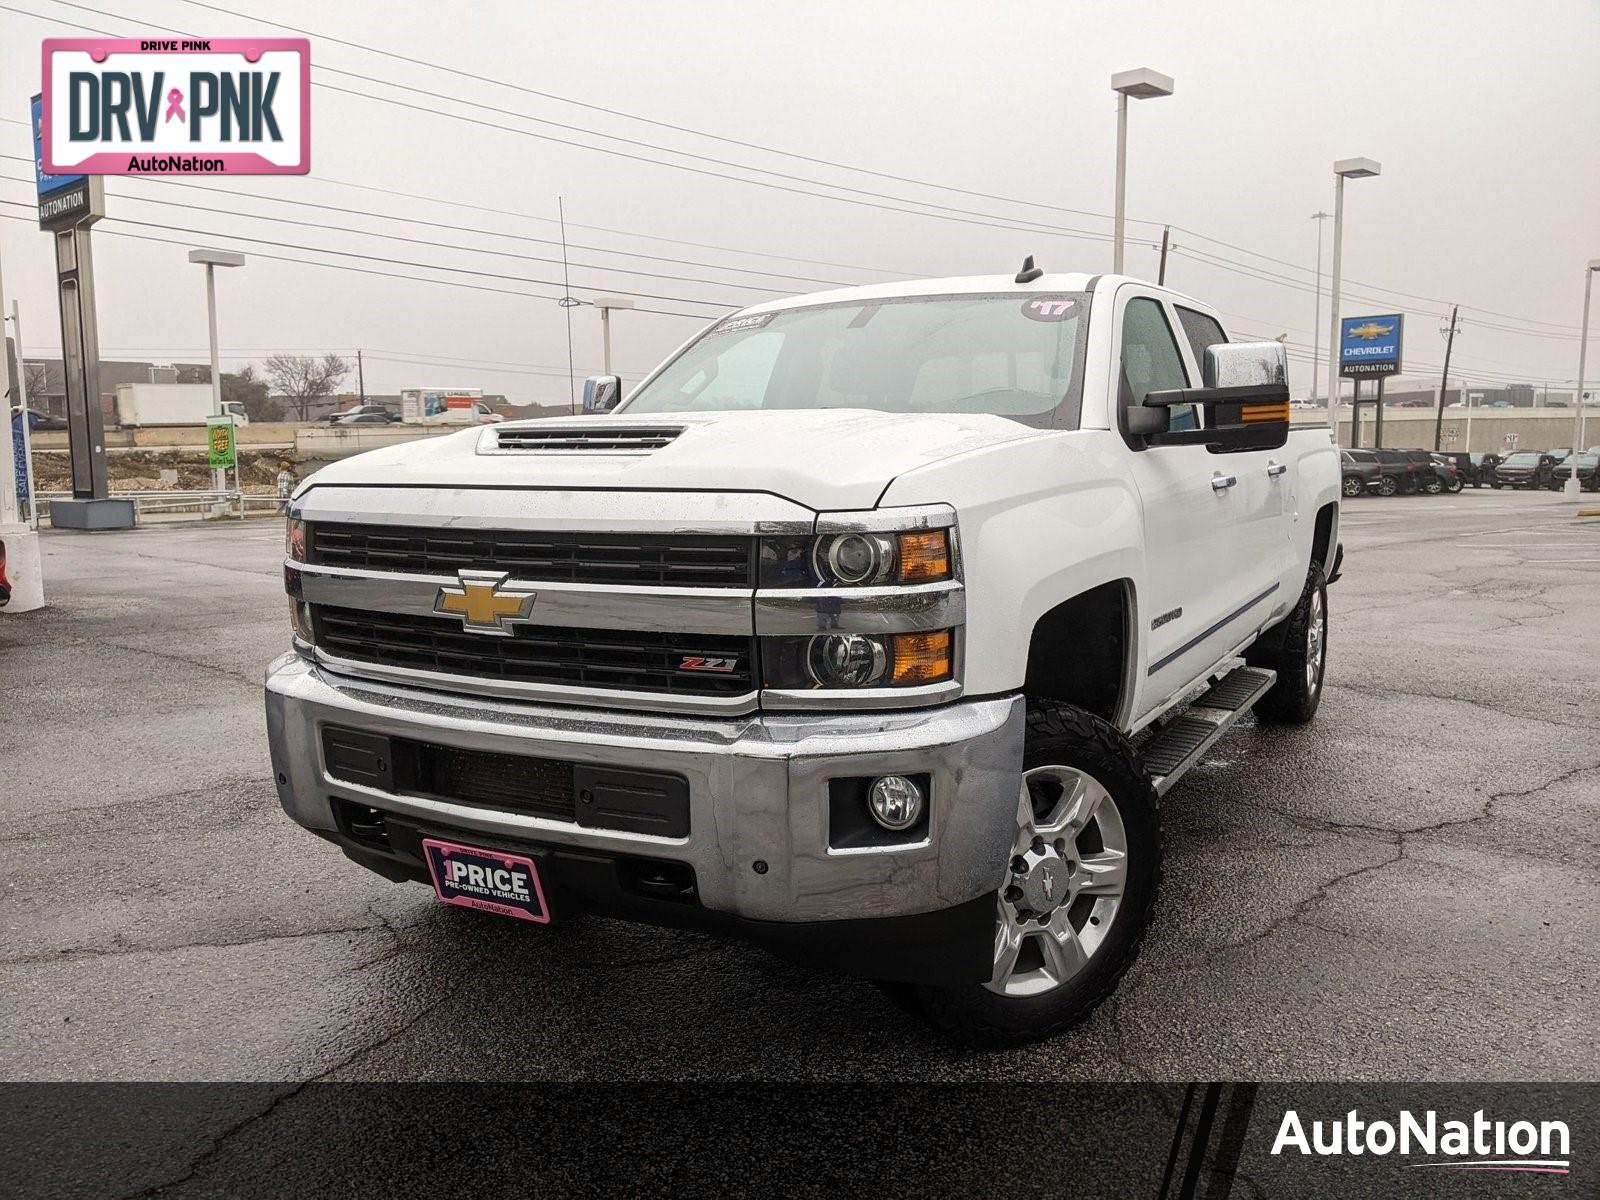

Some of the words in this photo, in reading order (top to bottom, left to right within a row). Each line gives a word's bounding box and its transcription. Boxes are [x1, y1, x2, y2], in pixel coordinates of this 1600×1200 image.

[40, 191, 84, 219] AUTONATION
[1344, 345, 1395, 356] CHEVROLET
[1344, 363, 1395, 373] AUTONATION
[18, 471, 28, 494] SALE
[679, 656, 738, 673] Z71
[445, 880, 490, 895] PRE-OWNED
[492, 889, 531, 902] VEHICLES
[471, 901, 513, 915] AutoNation
